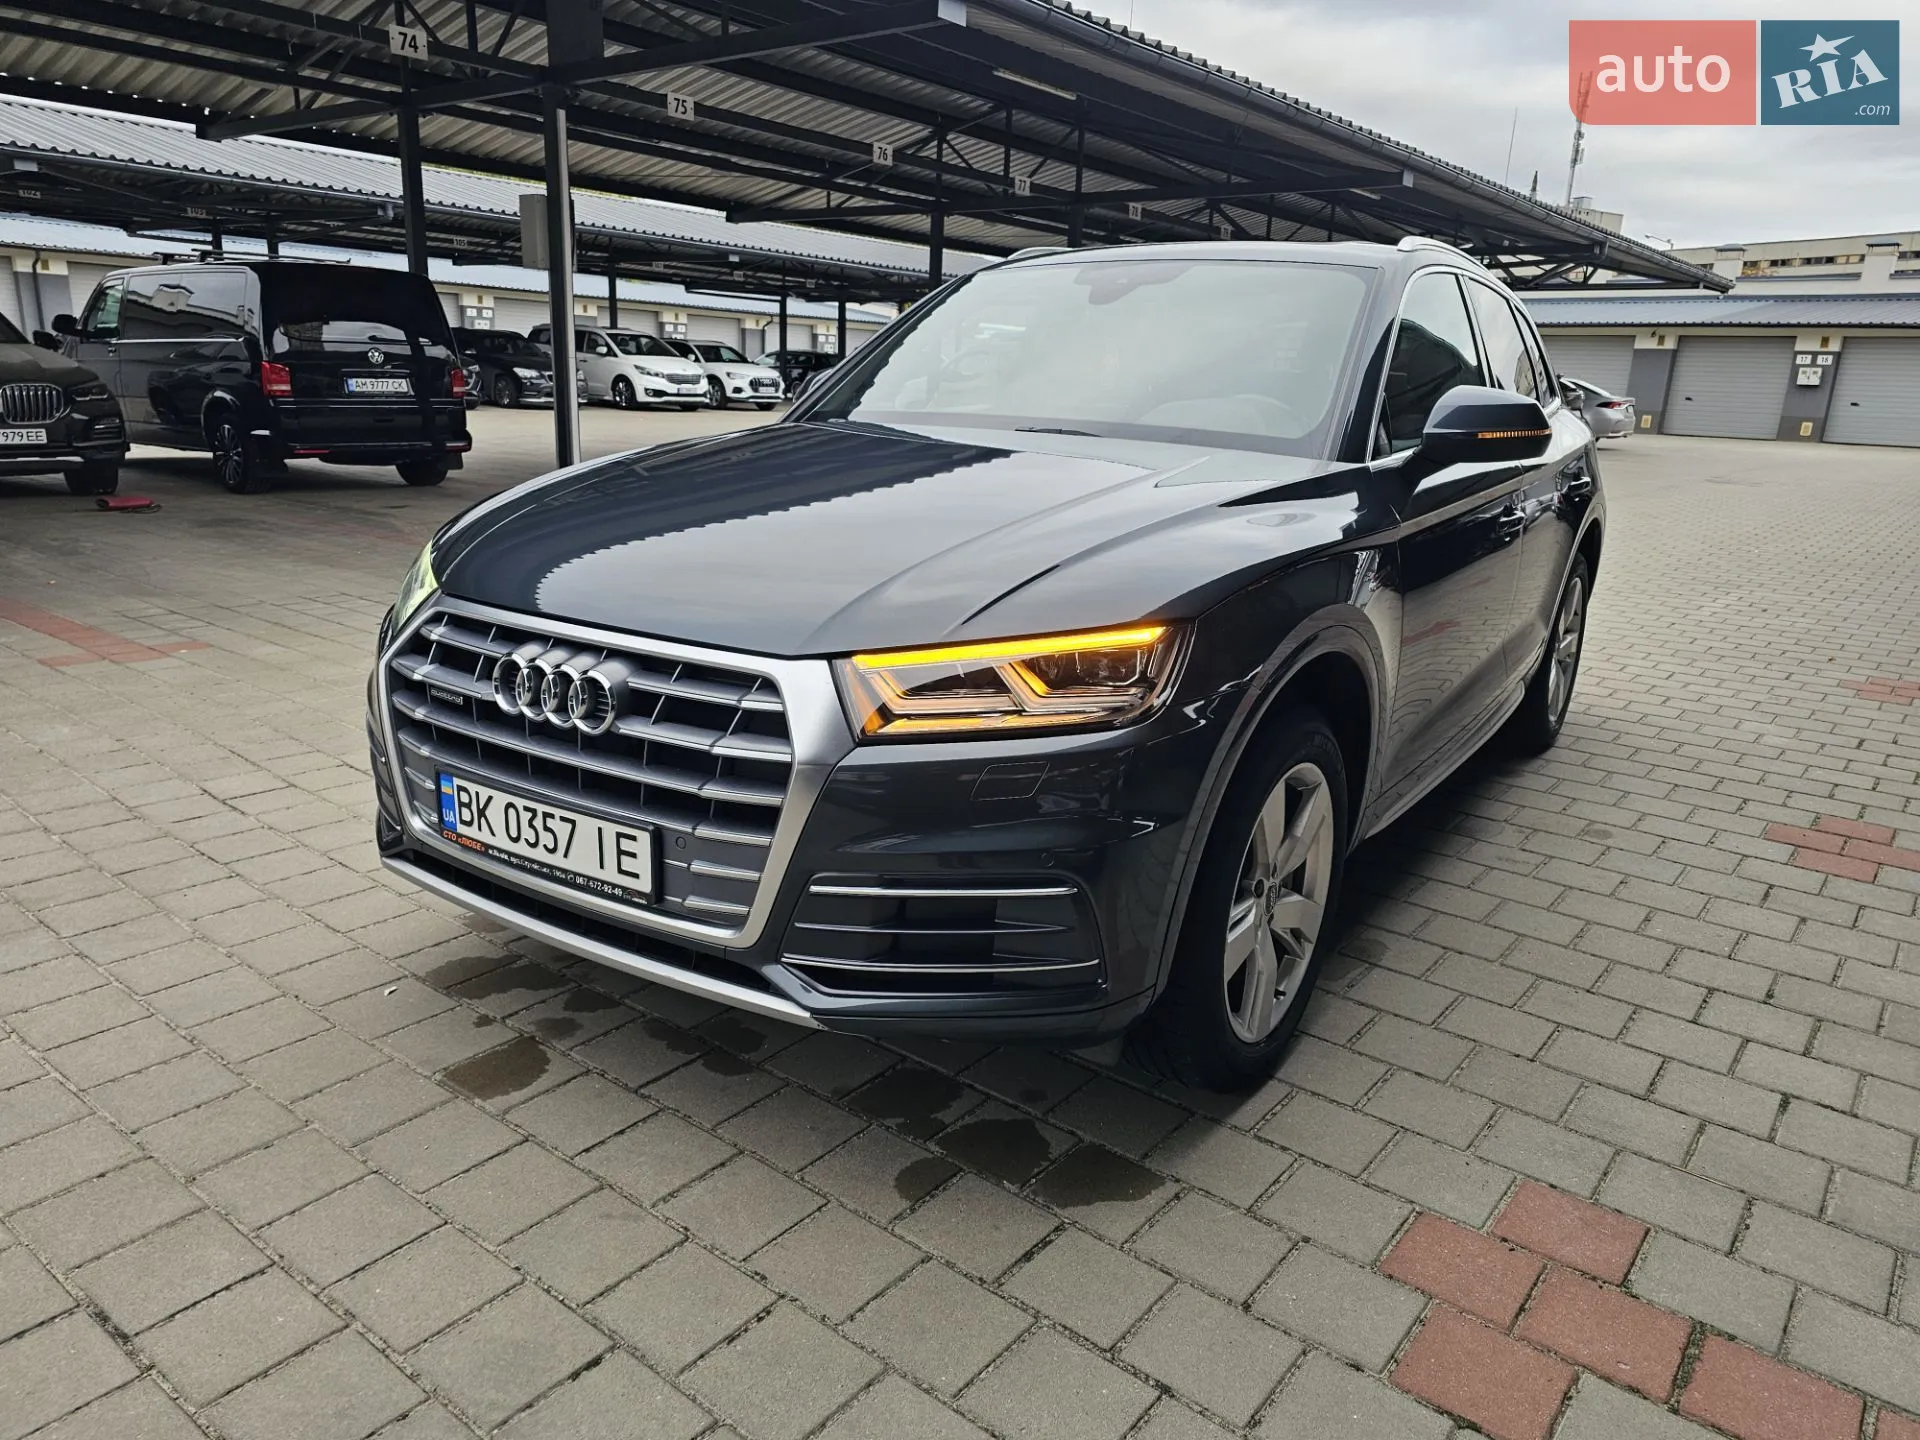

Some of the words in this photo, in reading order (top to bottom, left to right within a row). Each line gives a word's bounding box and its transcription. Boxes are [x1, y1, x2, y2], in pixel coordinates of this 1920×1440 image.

[398, 31, 419, 53] 74
[674, 97, 688, 115] 75
[878, 146, 888, 161] 76
[1018, 179, 1027, 192] 77
[355, 380, 368, 390] AM
[370, 380, 390, 390] 9777
[392, 380, 405, 390] CK
[0, 431, 24, 442] 979
[26, 430, 45, 442] EE
[442, 809, 456, 824] UA
[456, 784, 496, 837] BK
[504, 801, 577, 859] 0357
[597, 826, 641, 880] IE
